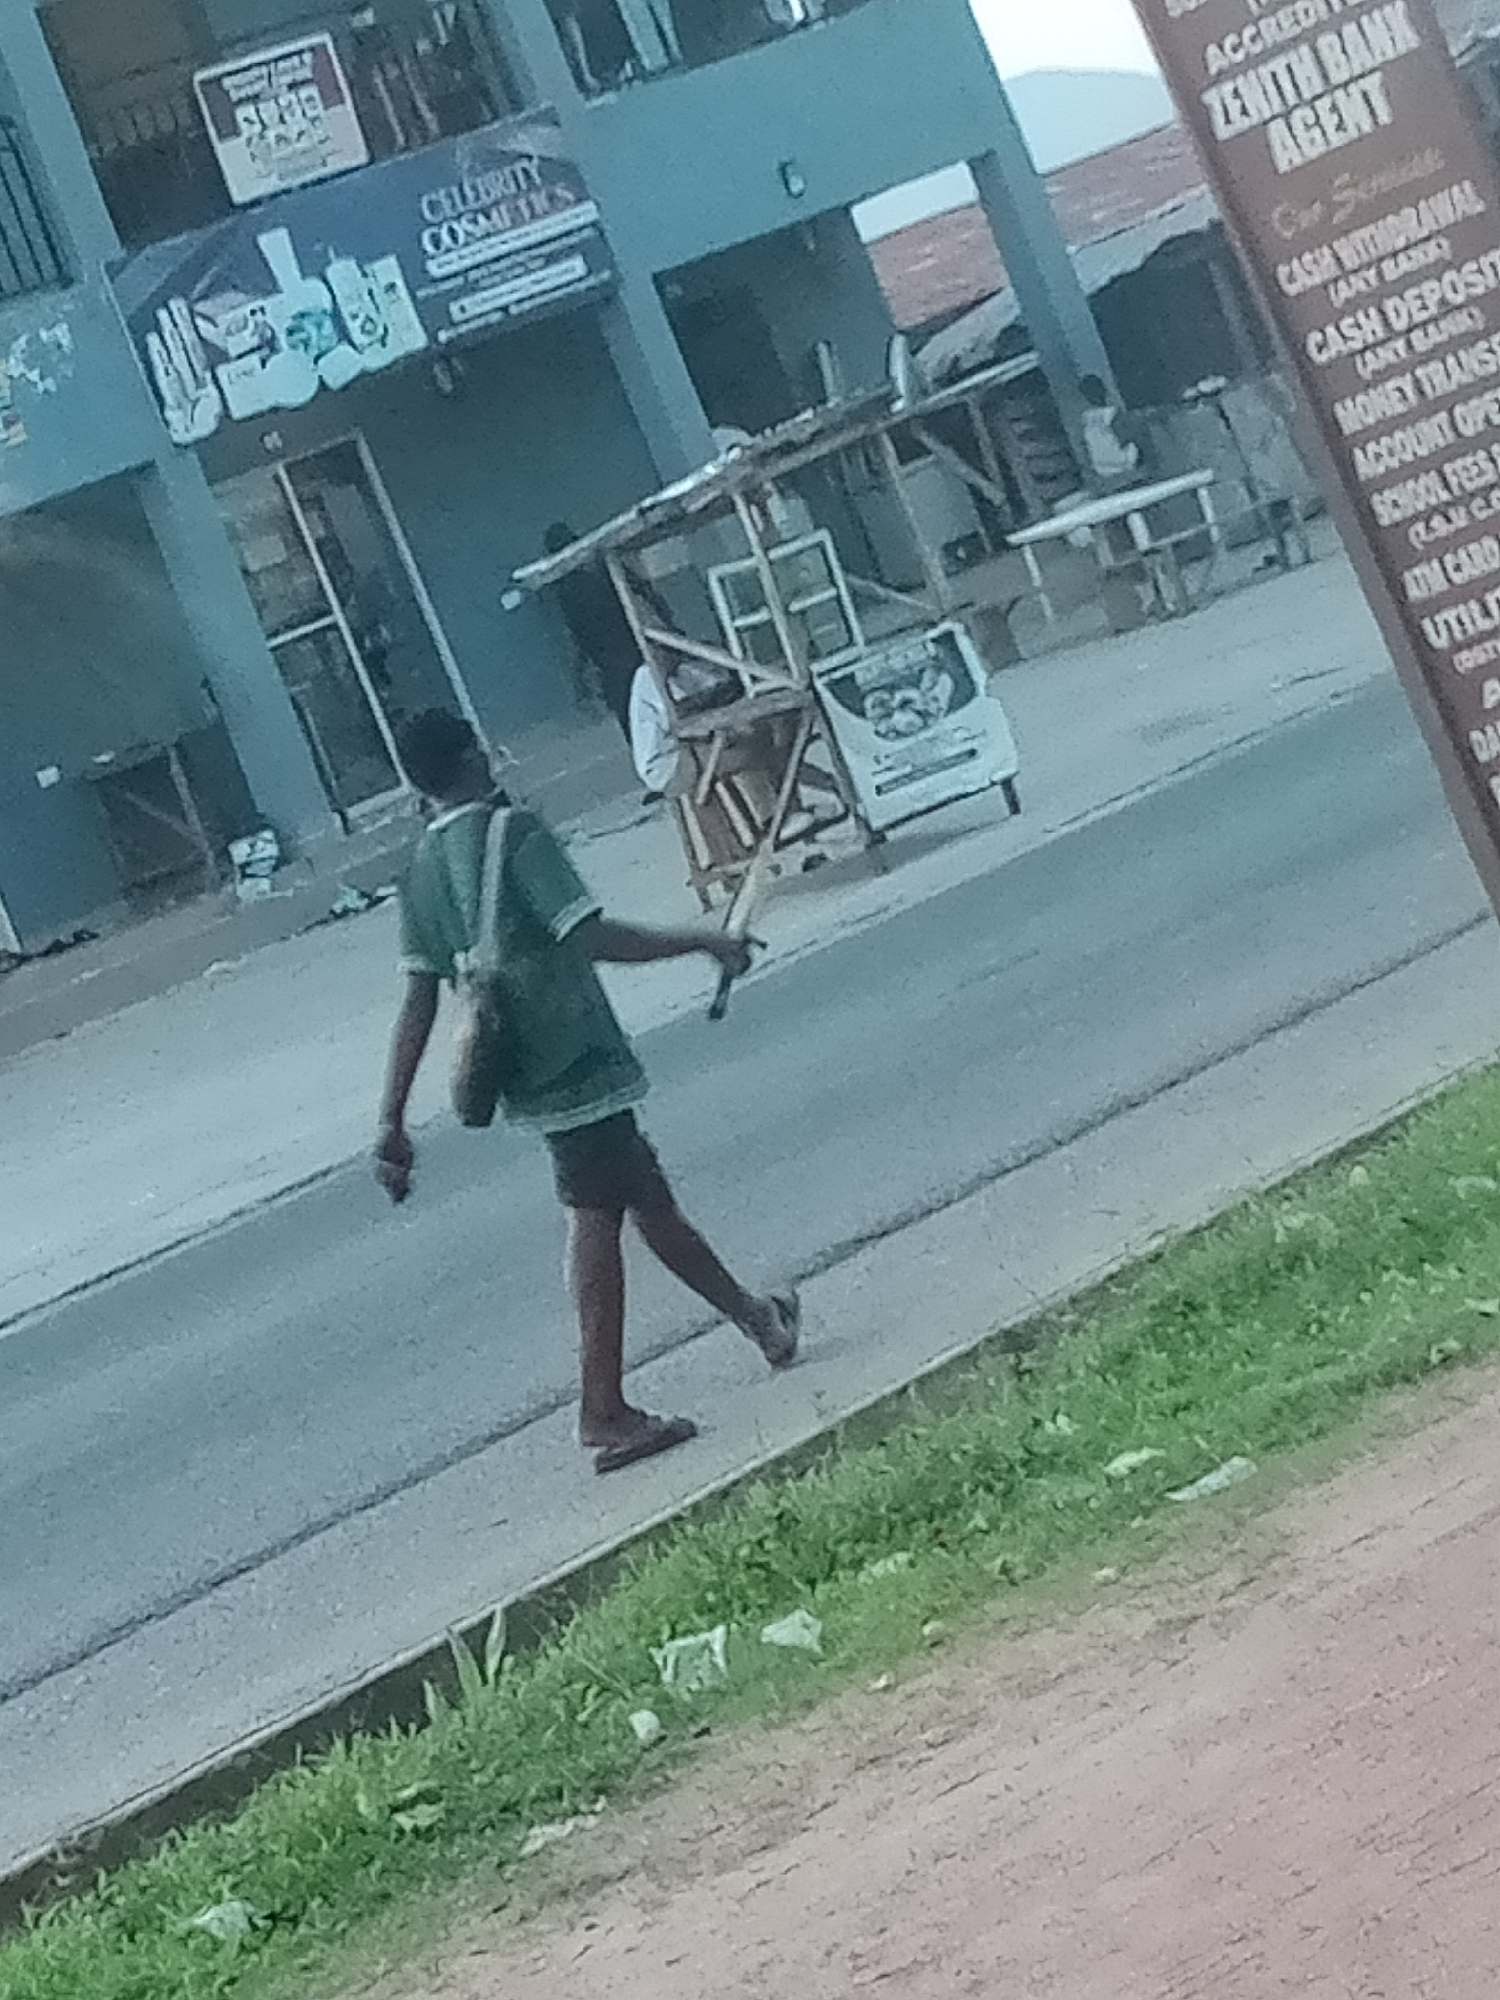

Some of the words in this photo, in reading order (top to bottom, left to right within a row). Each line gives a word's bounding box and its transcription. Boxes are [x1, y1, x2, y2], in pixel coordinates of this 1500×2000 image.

[1200, 43, 1328, 141] ZENITH
[1315, 2, 1421, 88] BANK
[1205, 0, 1358, 75] ACCREDI
[1266, 71, 1393, 174] AGENT
[1275, 244, 1343, 297] CASH
[1332, 180, 1486, 272] WITHDRAWAL
[1306, 307, 1385, 365] CASH
[1333, 373, 1418, 436] MONEY
[1353, 411, 1455, 482] ACCOUNT
[1452, 388, 1500, 438] OPE
[1369, 470, 1453, 527] SCHOOL
[1443, 449, 1498, 497] FEES
[1443, 536, 1500, 585] CARD
